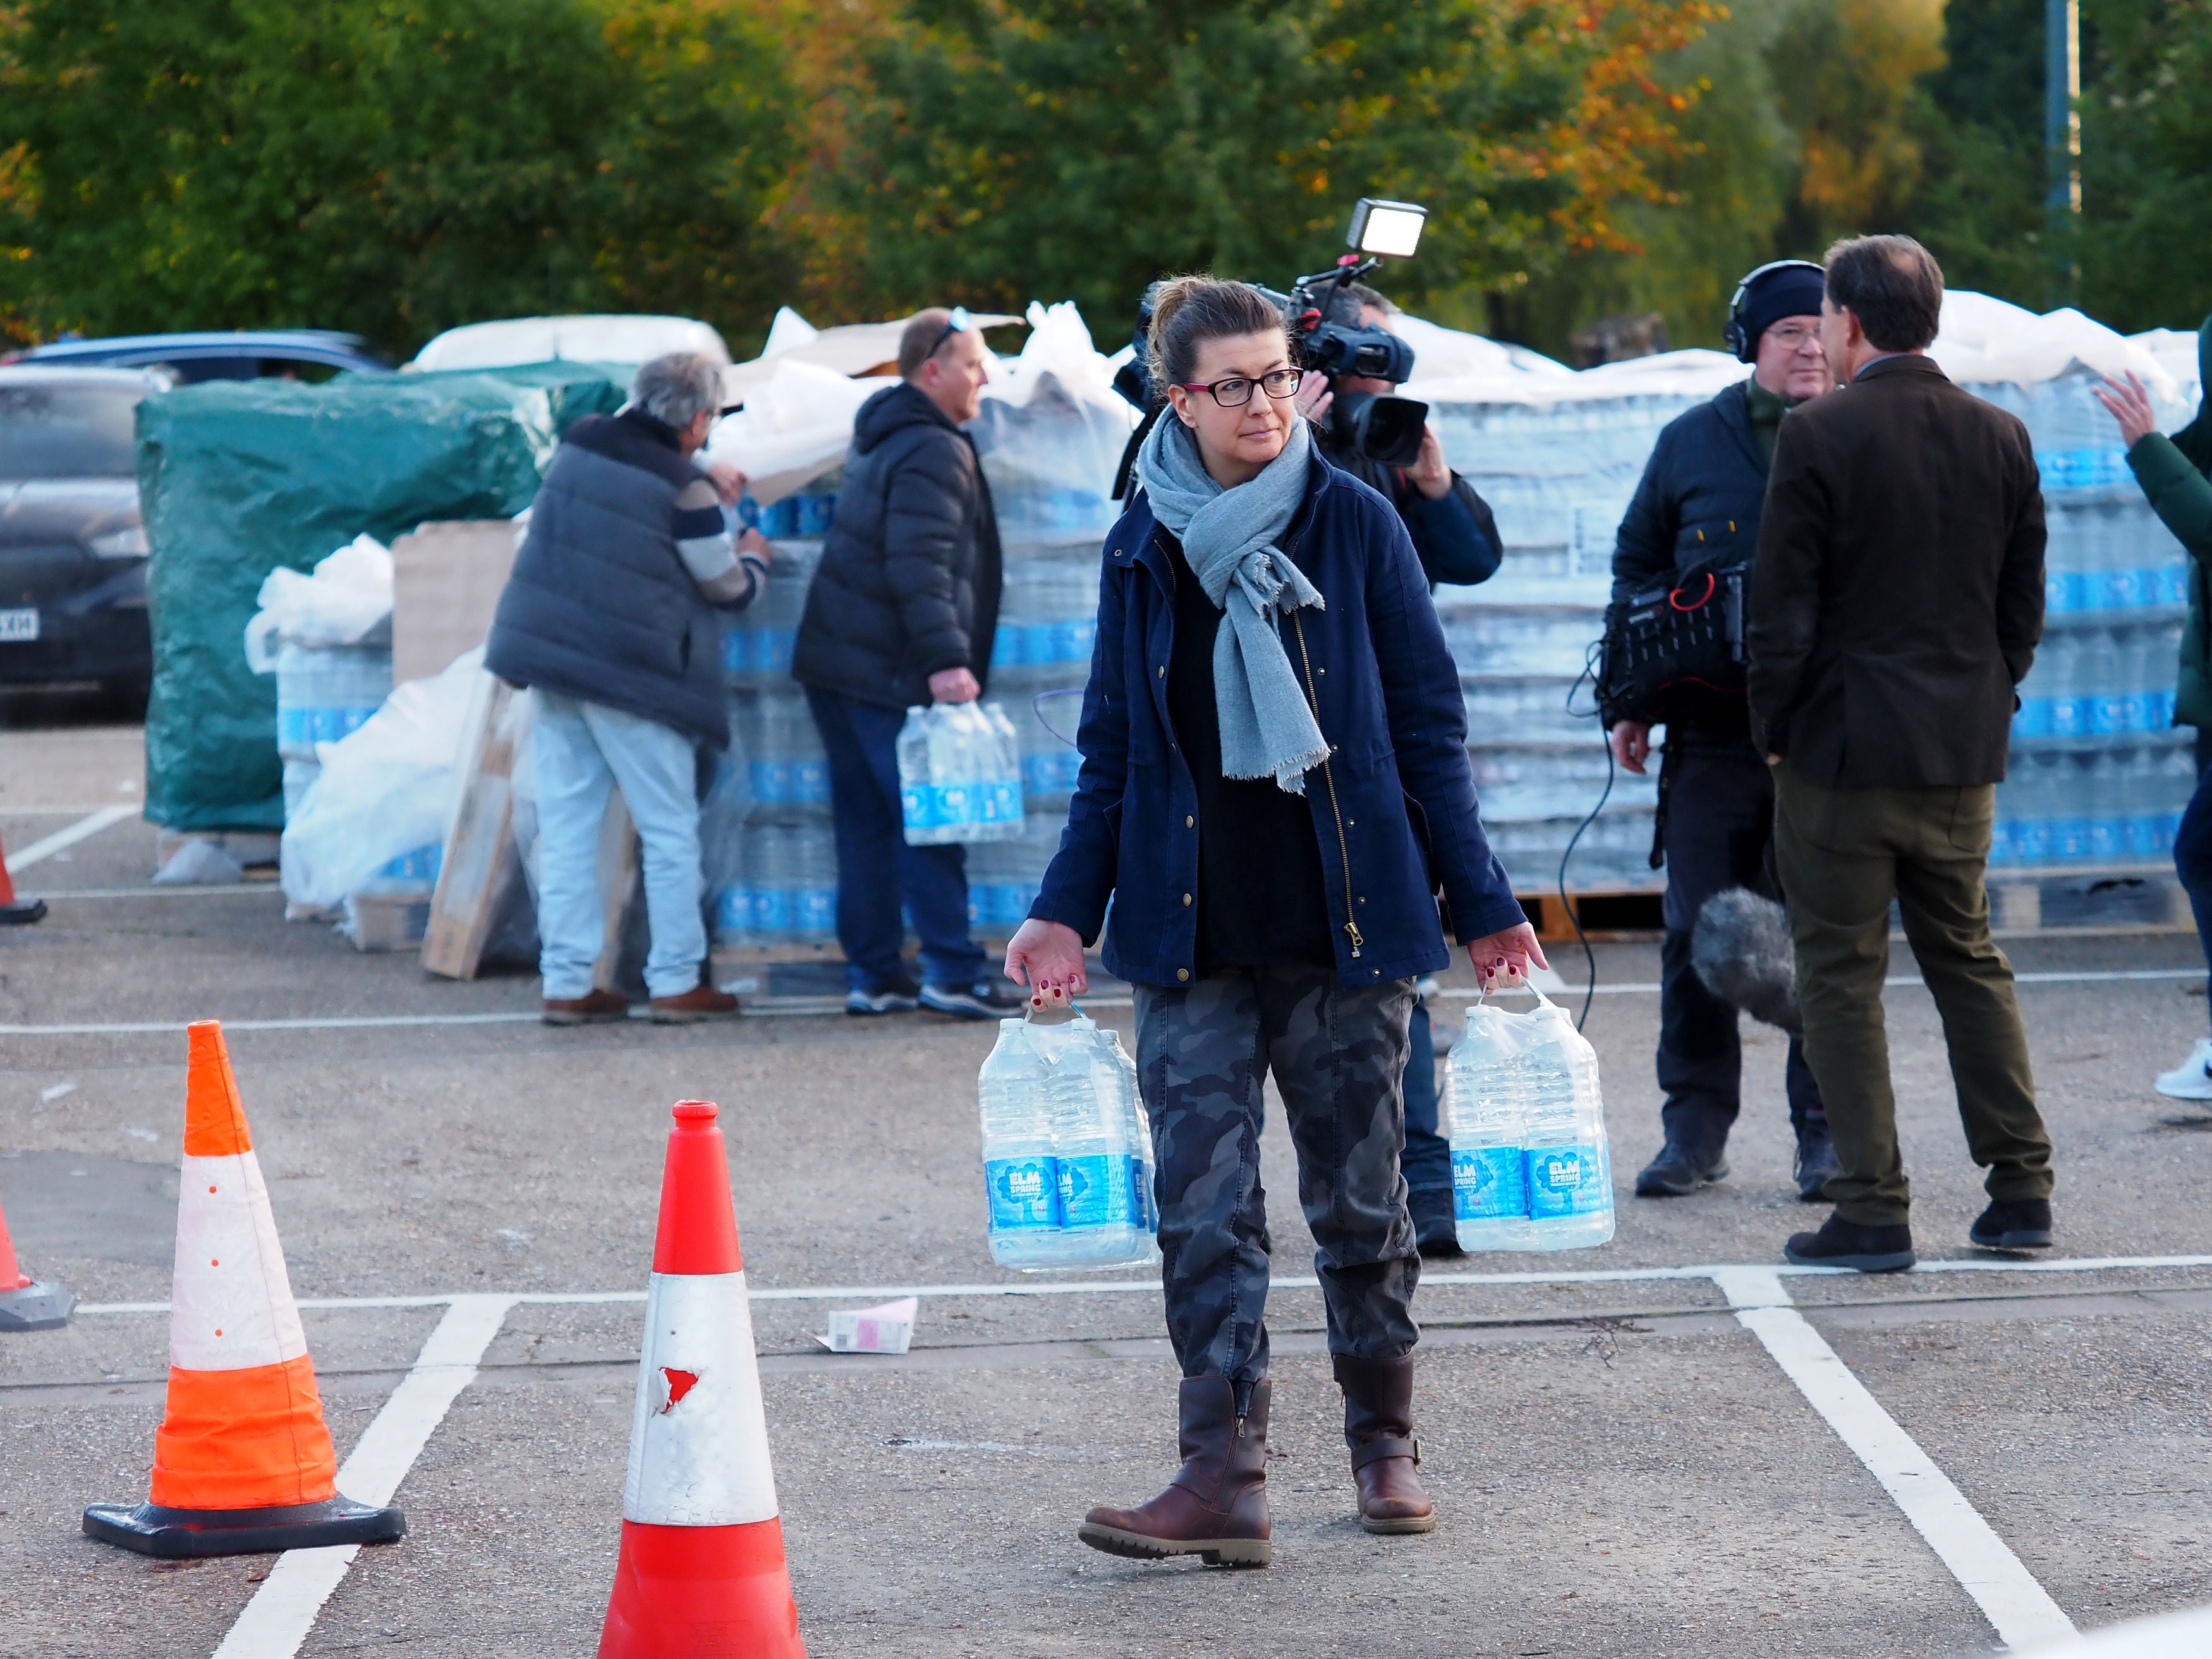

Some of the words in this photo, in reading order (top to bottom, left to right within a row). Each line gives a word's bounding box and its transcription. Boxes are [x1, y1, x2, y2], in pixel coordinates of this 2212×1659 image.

[1454, 1164, 1476, 1177] ELM
[1549, 1160, 1580, 1175] ELM
[1009, 1171, 1041, 1186] ELM
[1057, 1172, 1073, 1187] LM
[1454, 1177, 1476, 1186] SPRING
[1550, 1174, 1581, 1183] SPRING
[1011, 1184, 1041, 1194] SPRING
